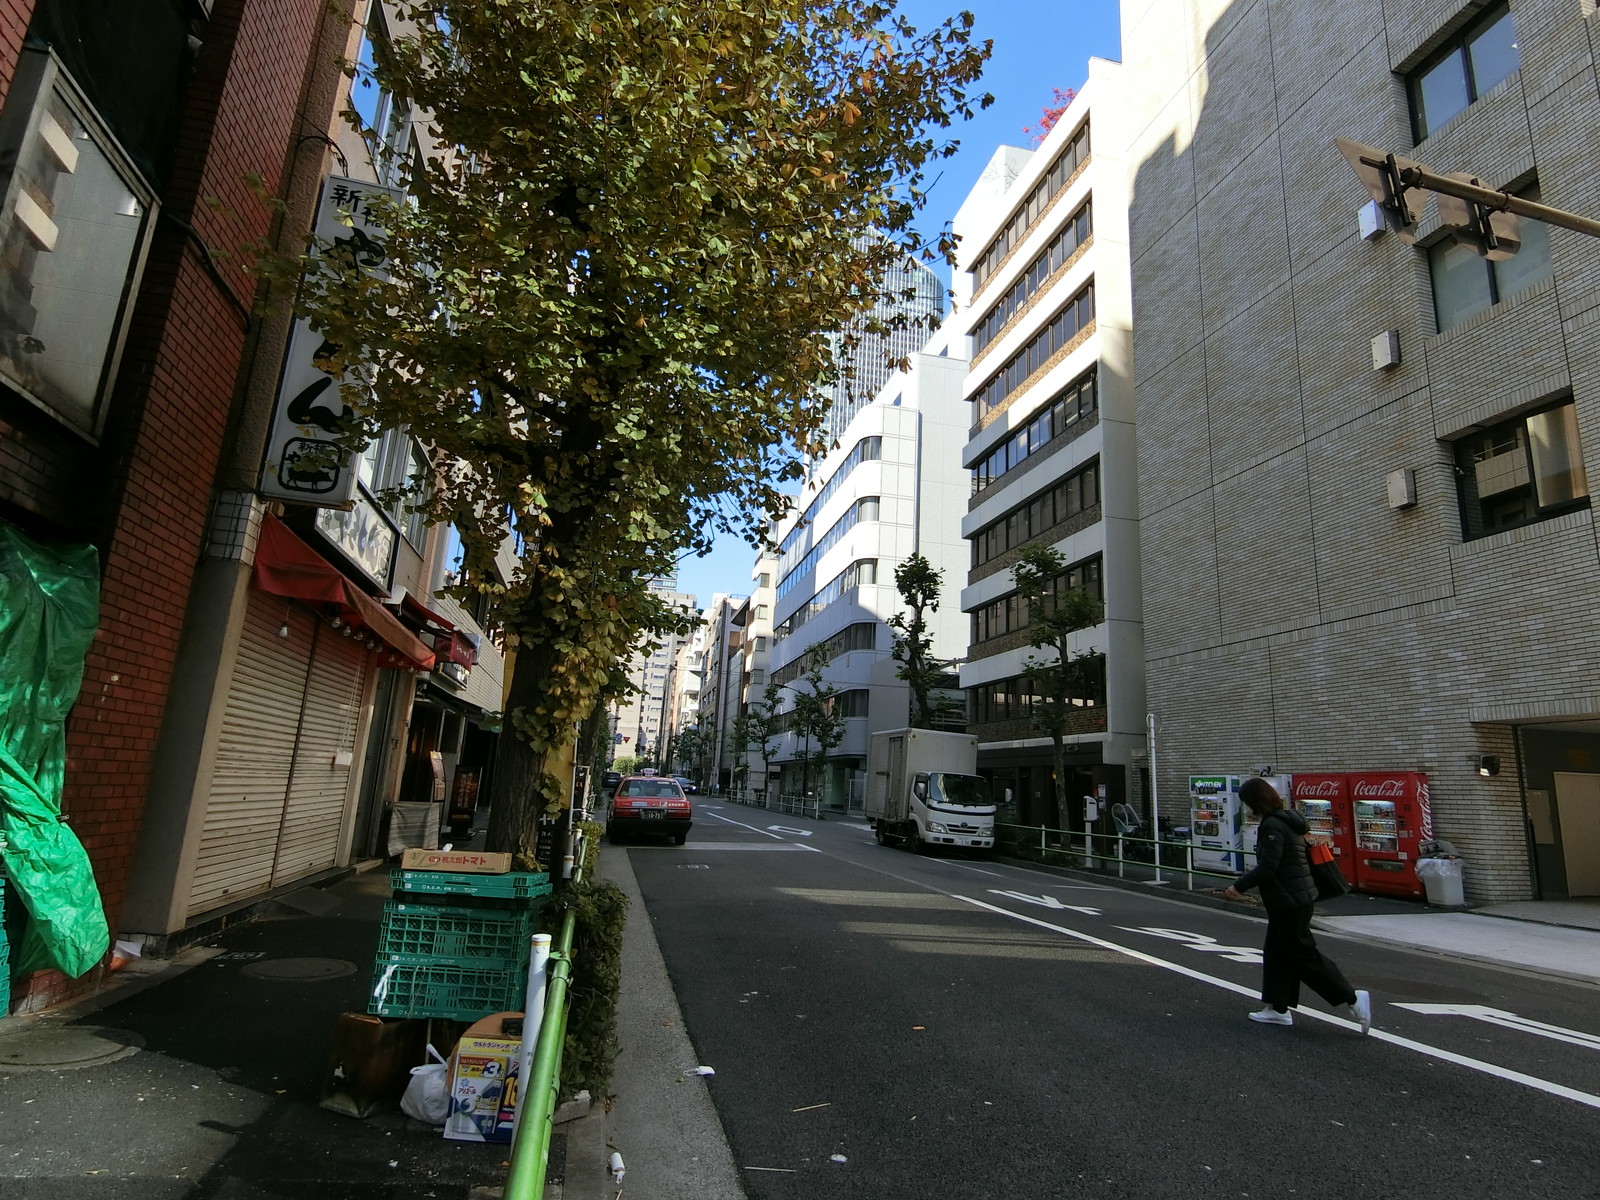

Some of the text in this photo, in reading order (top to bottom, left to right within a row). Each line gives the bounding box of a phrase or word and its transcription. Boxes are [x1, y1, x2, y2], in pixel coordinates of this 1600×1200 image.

[1296, 780, 1341, 796] Coca-Cola
[1354, 780, 1405, 796] Coca-Cola
[1416, 780, 1433, 841] Coca-Cola
[441, 856, 486, 866] 桃太郎トマト
[458, 1087, 476, 1095] アリエール
